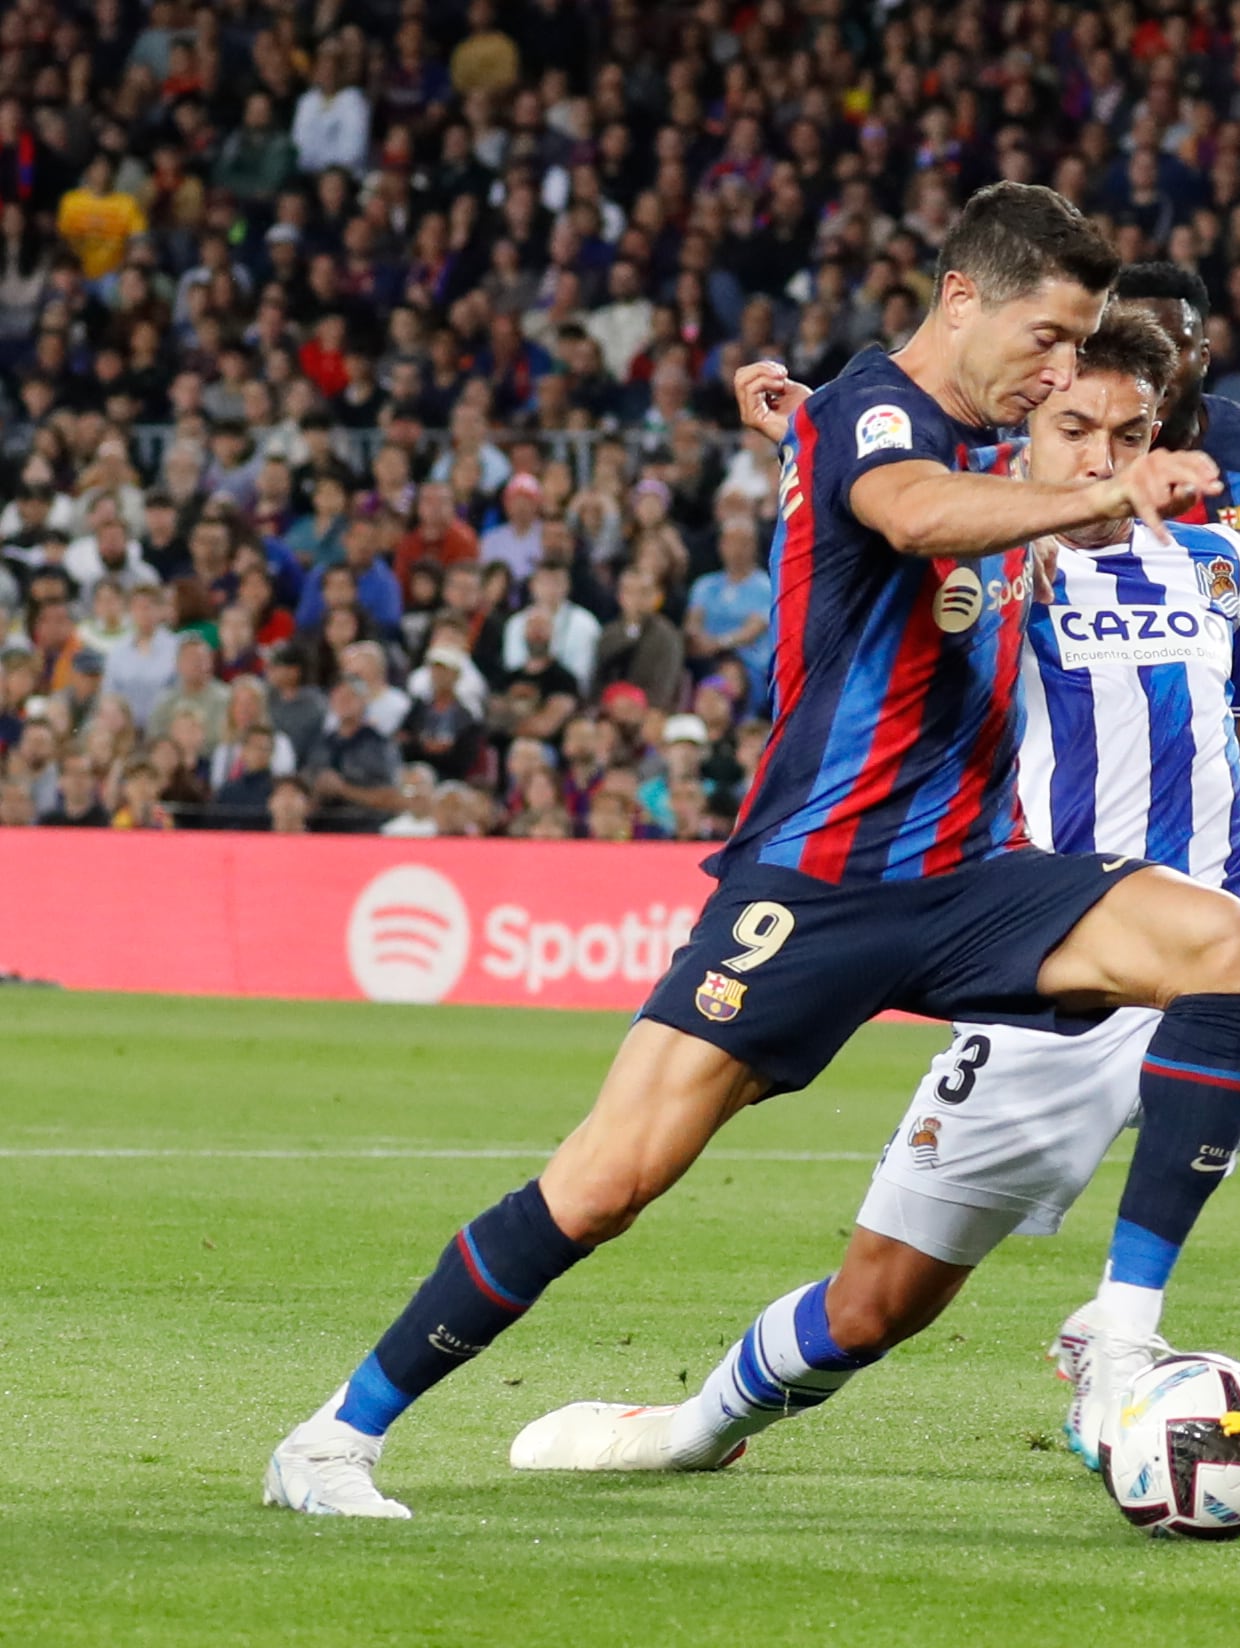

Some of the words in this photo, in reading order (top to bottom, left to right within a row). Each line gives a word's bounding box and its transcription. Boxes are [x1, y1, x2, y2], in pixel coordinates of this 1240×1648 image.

[482, 904, 696, 994] Spotif
[721, 900, 796, 974] 9
[934, 1034, 991, 1105] 3
